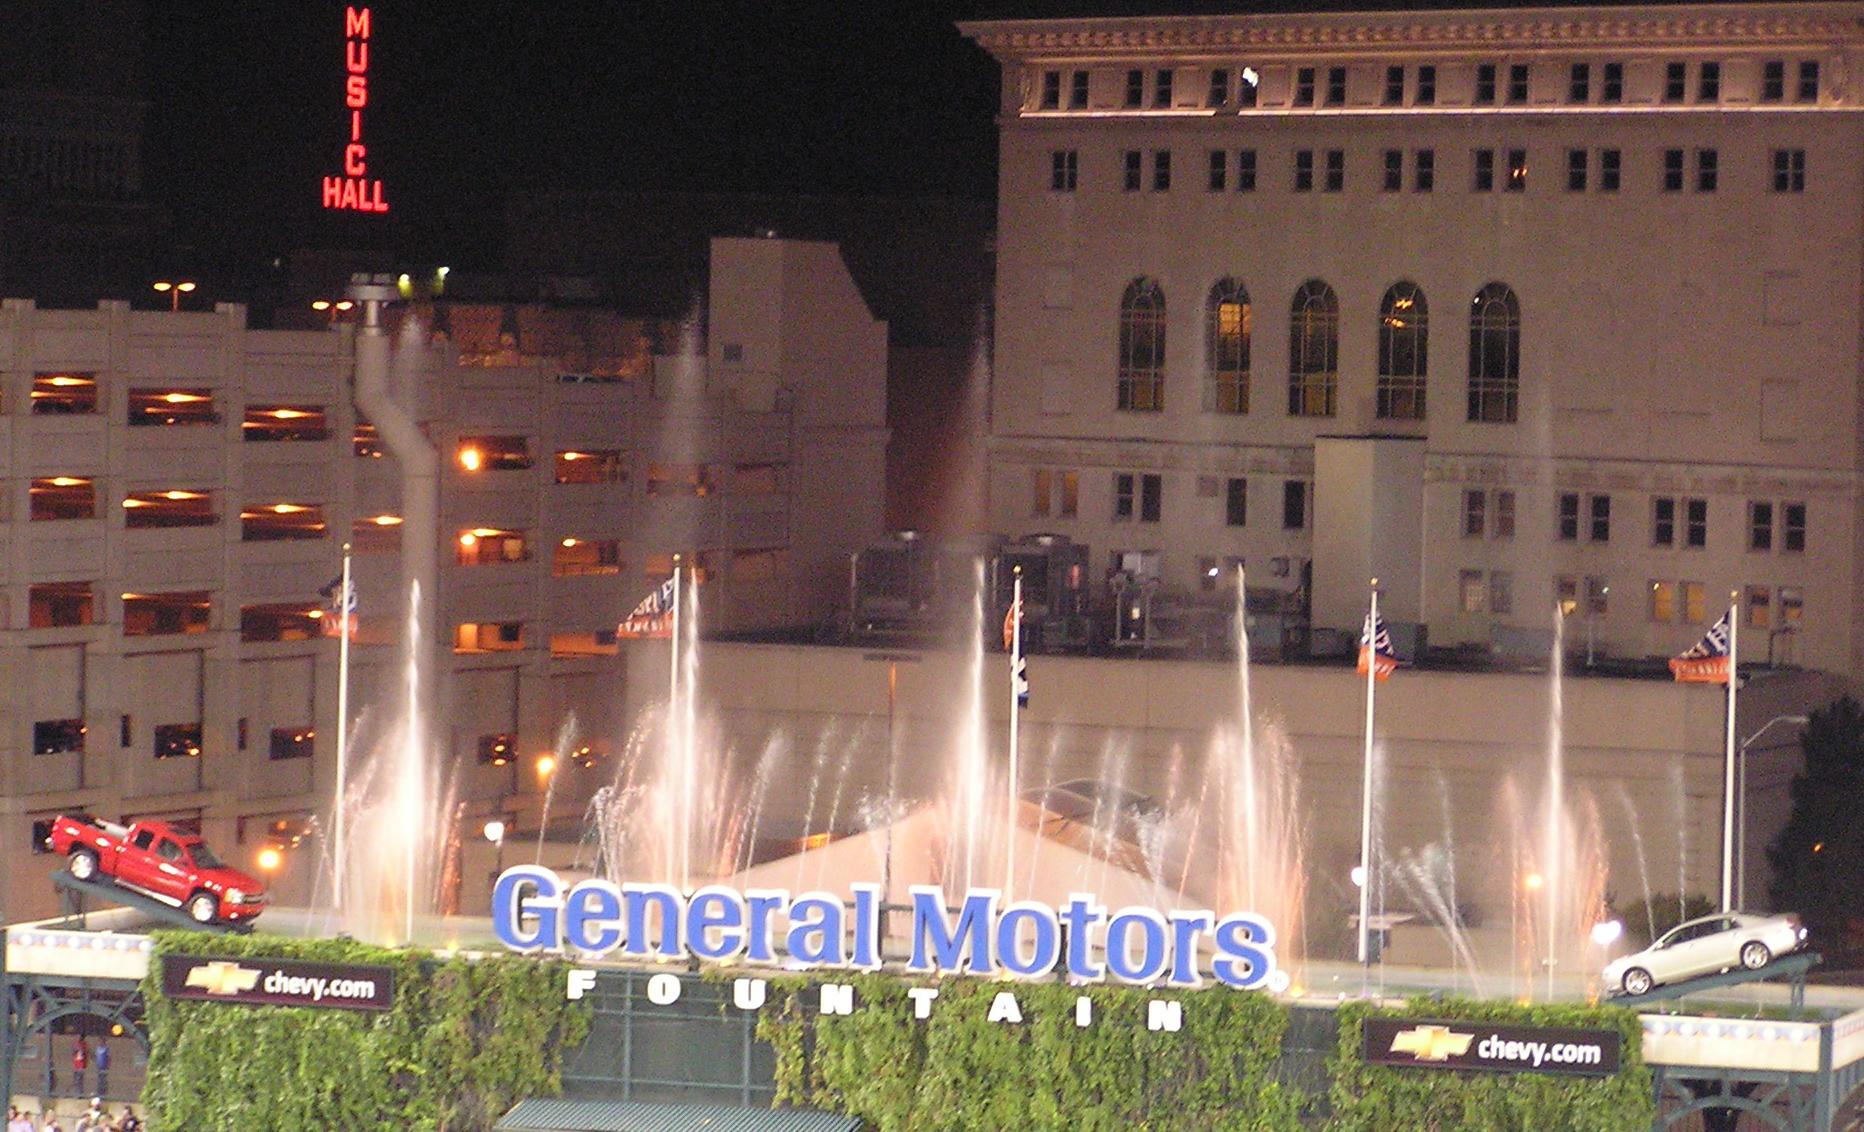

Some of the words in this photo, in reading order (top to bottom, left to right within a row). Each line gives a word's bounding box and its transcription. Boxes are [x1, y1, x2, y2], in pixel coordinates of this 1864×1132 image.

[345, 6, 370, 177] MUSIC
[322, 176, 390, 212] HALL
[492, 864, 882, 971] General
[905, 884, 1277, 990] Motors
[263, 970, 376, 1001] chevy.com
[566, 969, 1182, 1032] FOUNTAIN
[1477, 1034, 1601, 1067] chevy.com
